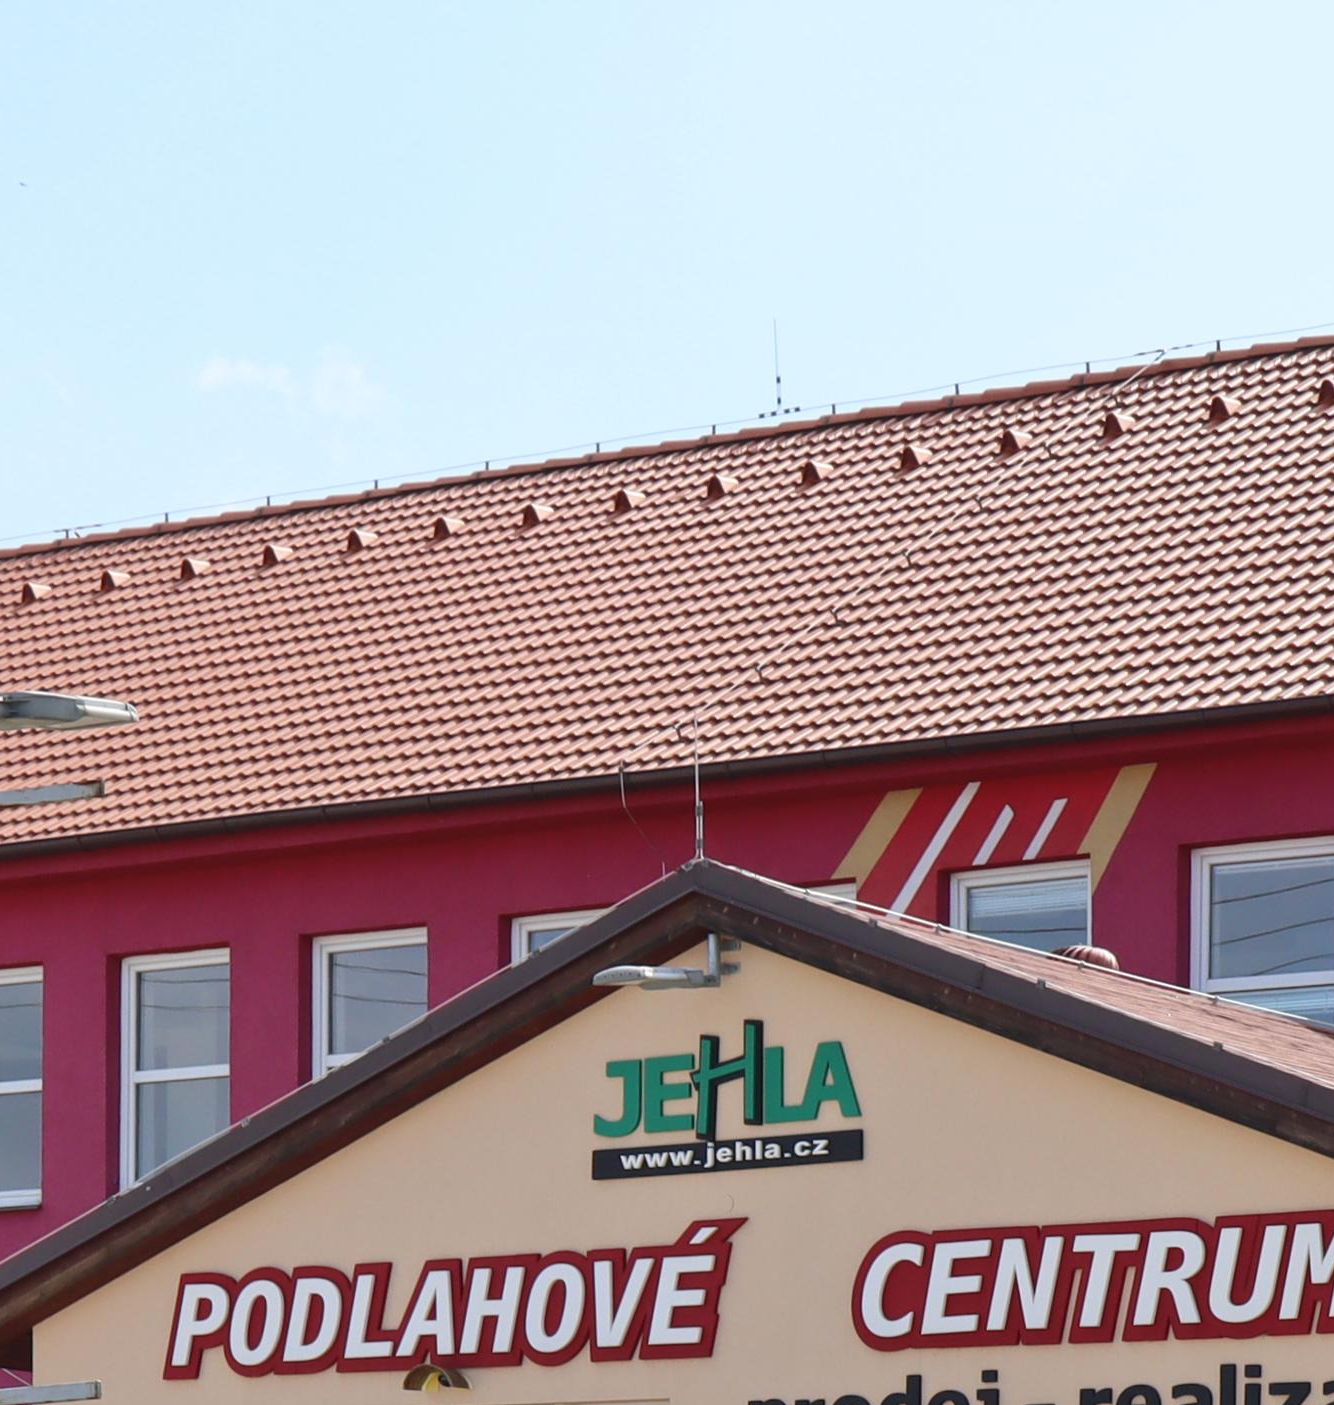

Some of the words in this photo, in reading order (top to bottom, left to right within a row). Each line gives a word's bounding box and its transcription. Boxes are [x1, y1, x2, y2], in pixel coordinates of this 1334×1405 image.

[593, 1019, 862, 1141] JEHLA
[620, 1137, 830, 1171] www.jehla.cz
[170, 1226, 717, 1368] PODLAHOVÉ
